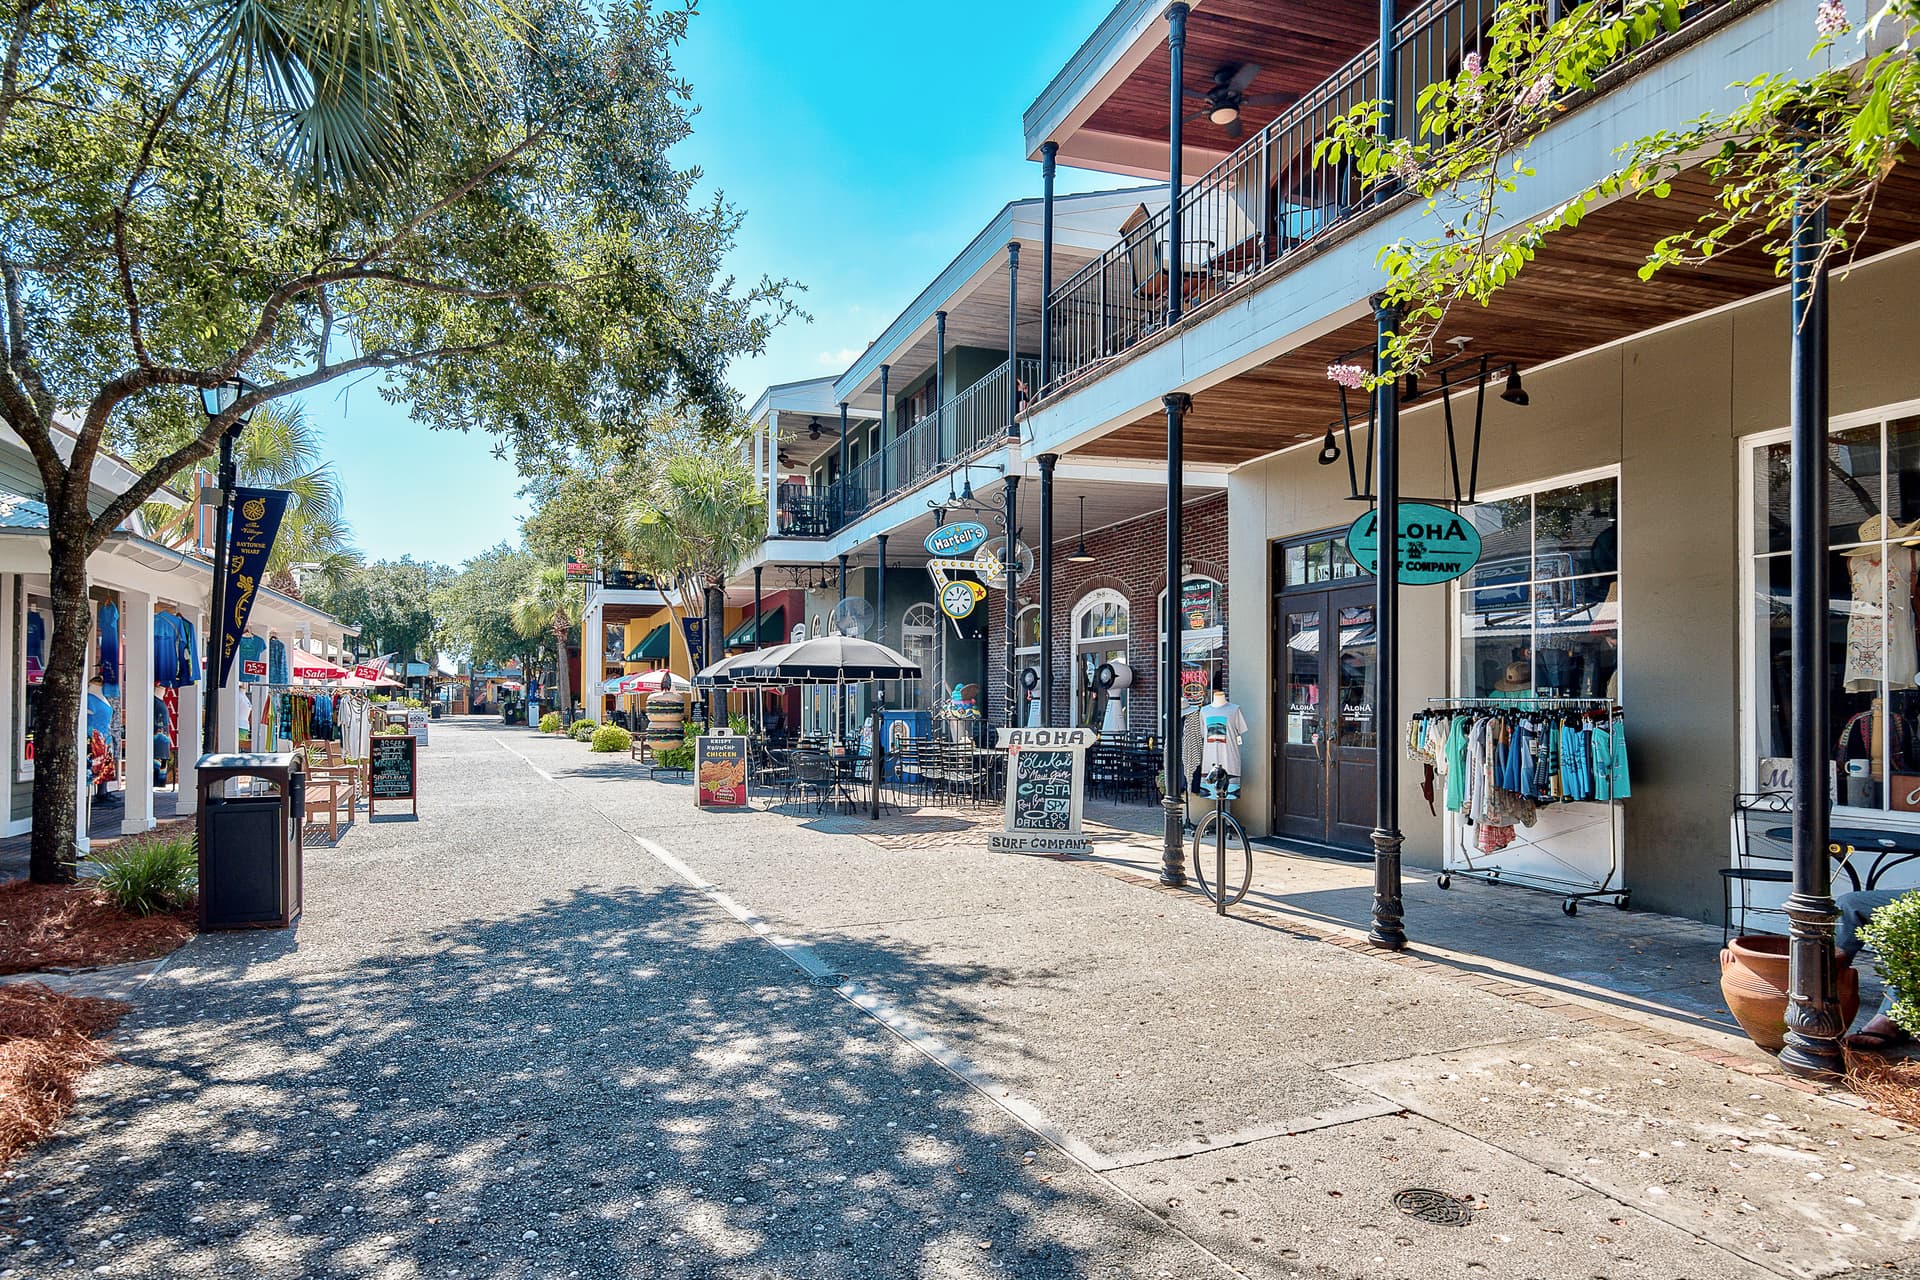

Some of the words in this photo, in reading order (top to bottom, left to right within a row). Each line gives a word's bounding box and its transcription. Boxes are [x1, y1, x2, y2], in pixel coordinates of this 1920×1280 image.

[934, 527, 983, 551] Hartell's
[1371, 561, 1403, 571] SF
[1405, 561, 1461, 573] COMPANY
[303, 668, 326, 679] Sale
[1344, 704, 1372, 712] ALOHA
[1009, 730, 1085, 746] ALOHA
[1018, 783, 1070, 796] COSTA
[1046, 800, 1067, 811] SPY
[1016, 818, 1057, 829] OAKLEY
[992, 837, 1028, 849] SURF
[1030, 838, 1088, 850] COMPANY
